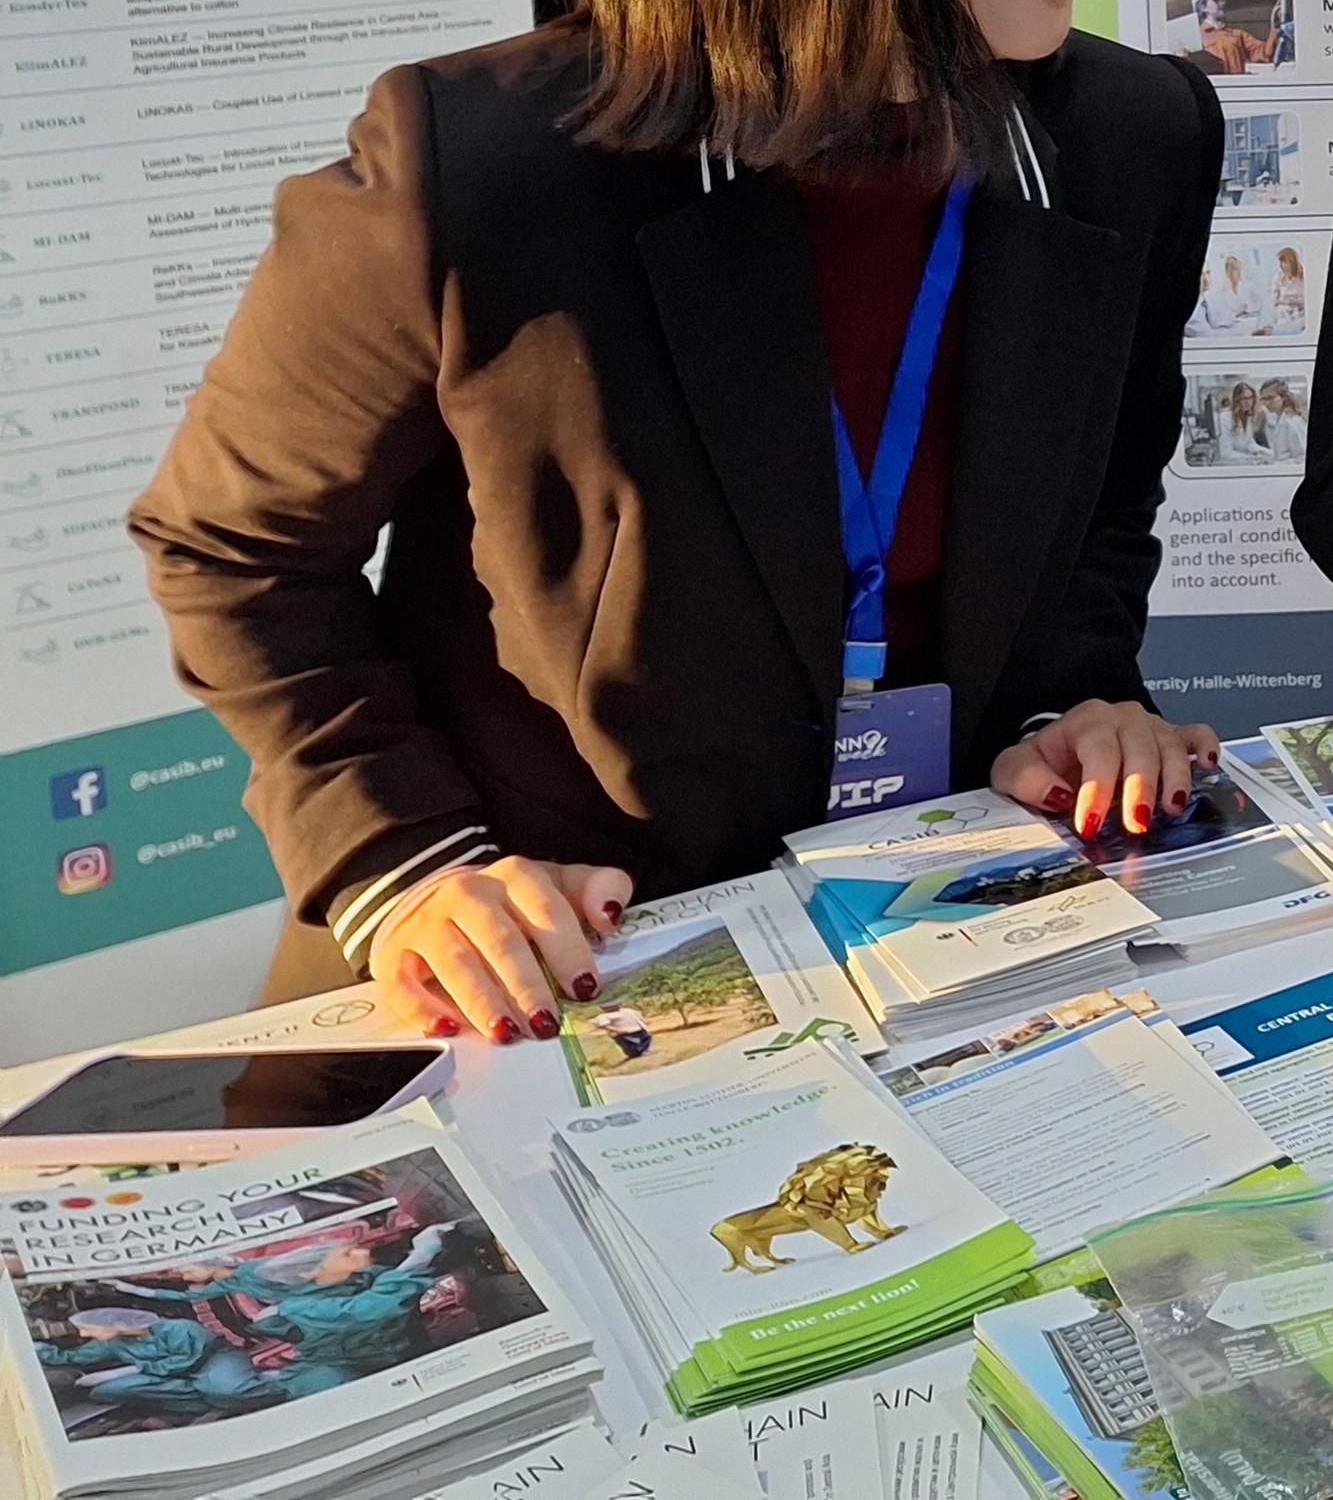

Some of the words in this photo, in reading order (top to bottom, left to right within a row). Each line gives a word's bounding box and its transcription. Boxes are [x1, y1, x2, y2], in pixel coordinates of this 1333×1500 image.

[1168, 507, 1274, 526] Applications
[1171, 573, 1205, 589] into
[1209, 572, 1282, 588] account.
[1192, 672, 1323, 690] Halle-Wittenberg
[1284, 890, 1331, 909] DFG
[1257, 1001, 1333, 1033] CENTRAL
[600, 1130, 706, 1161] Creating
[610, 1152, 675, 1174] Since
[19, 1198, 205, 1234] FUNDING
[218, 1167, 322, 1203] YOUR
[26, 1210, 225, 1250] RESEARCH
[30, 1253, 75, 1269] IN
[90, 1210, 291, 1263] GERMANY
[750, 1326, 780, 1341] Be
[783, 1316, 818, 1332] the
[822, 1300, 868, 1321] next
